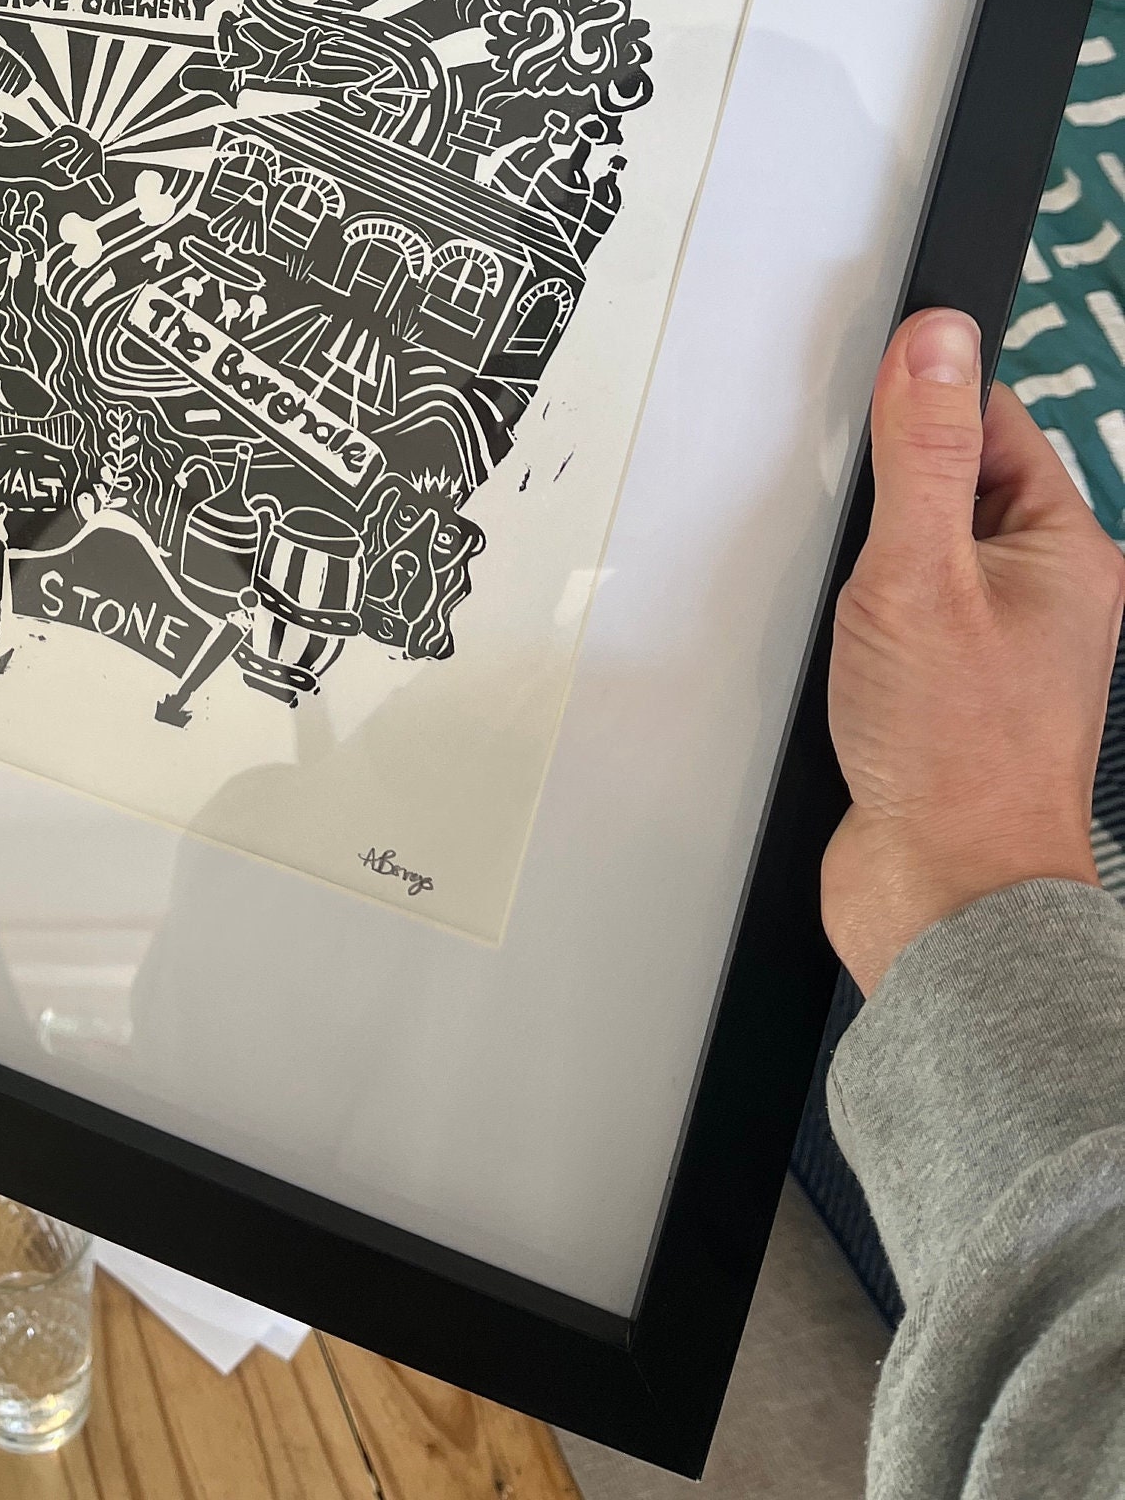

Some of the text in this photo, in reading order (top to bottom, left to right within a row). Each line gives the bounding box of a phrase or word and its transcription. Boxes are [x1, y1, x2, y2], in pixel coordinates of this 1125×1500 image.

[149, 299, 367, 473] The Borehole
[40, 570, 189, 660] STONE
